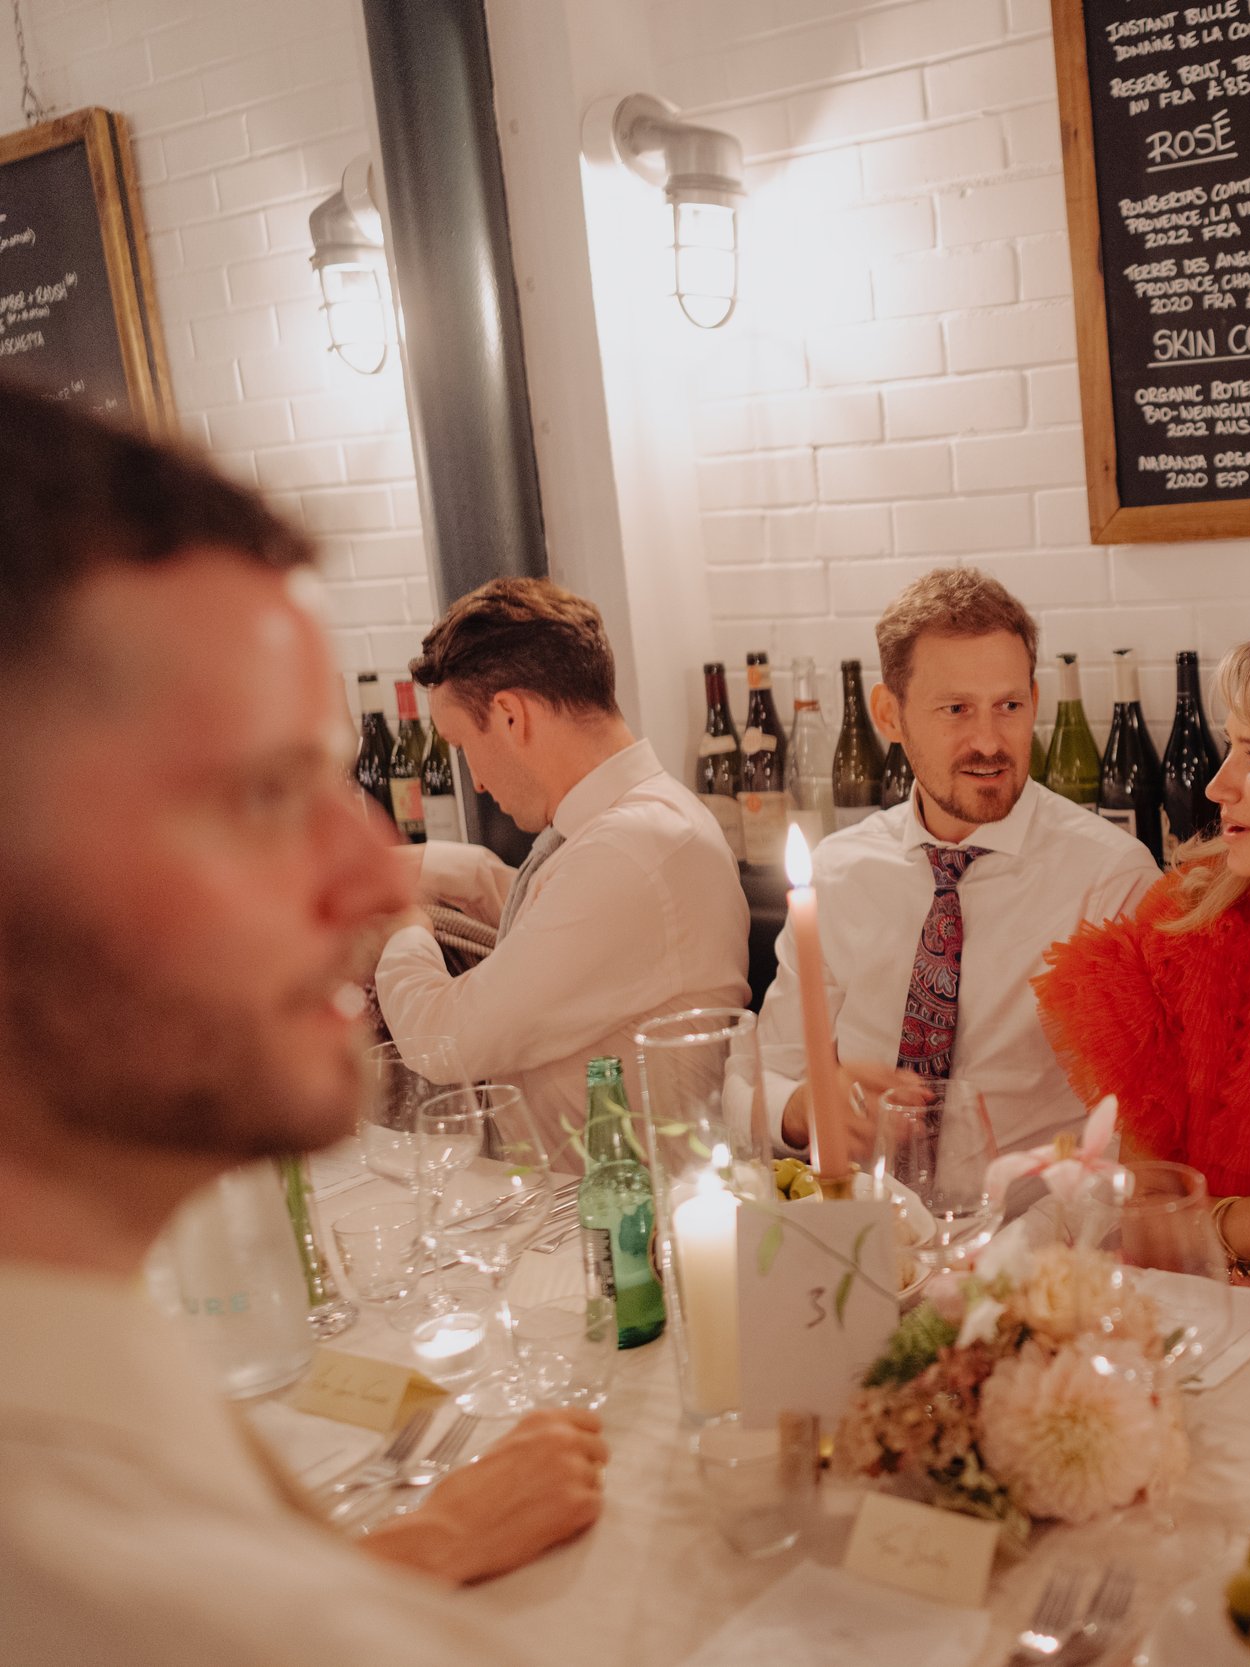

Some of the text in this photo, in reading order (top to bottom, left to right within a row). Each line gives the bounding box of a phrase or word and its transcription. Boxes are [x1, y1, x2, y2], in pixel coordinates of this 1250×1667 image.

[1105, 11, 1179, 43] INSTANT
[1177, 30, 1200, 49] DE
[1202, 25, 1224, 44] LA
[1159, 87, 1196, 109] FRA
[1145, 108, 1236, 163] ROSÉ
[1209, 203, 1232, 222] LA
[1145, 228, 1194, 250] 2022
[1201, 221, 1242, 241] FRA
[1123, 258, 1178, 281] TERRES
[1182, 256, 1210, 275] DES
[1135, 275, 1219, 298] PROVENCE,
[1150, 295, 1194, 315] 2020
[1203, 293, 1236, 309] FRA
[1153, 328, 1216, 361] SKIN
[1134, 384, 1204, 405] ORGANIC
[1166, 421, 1210, 438] 2022
[1166, 471, 1209, 489] 2020
[1215, 470, 1250, 488] ESP
